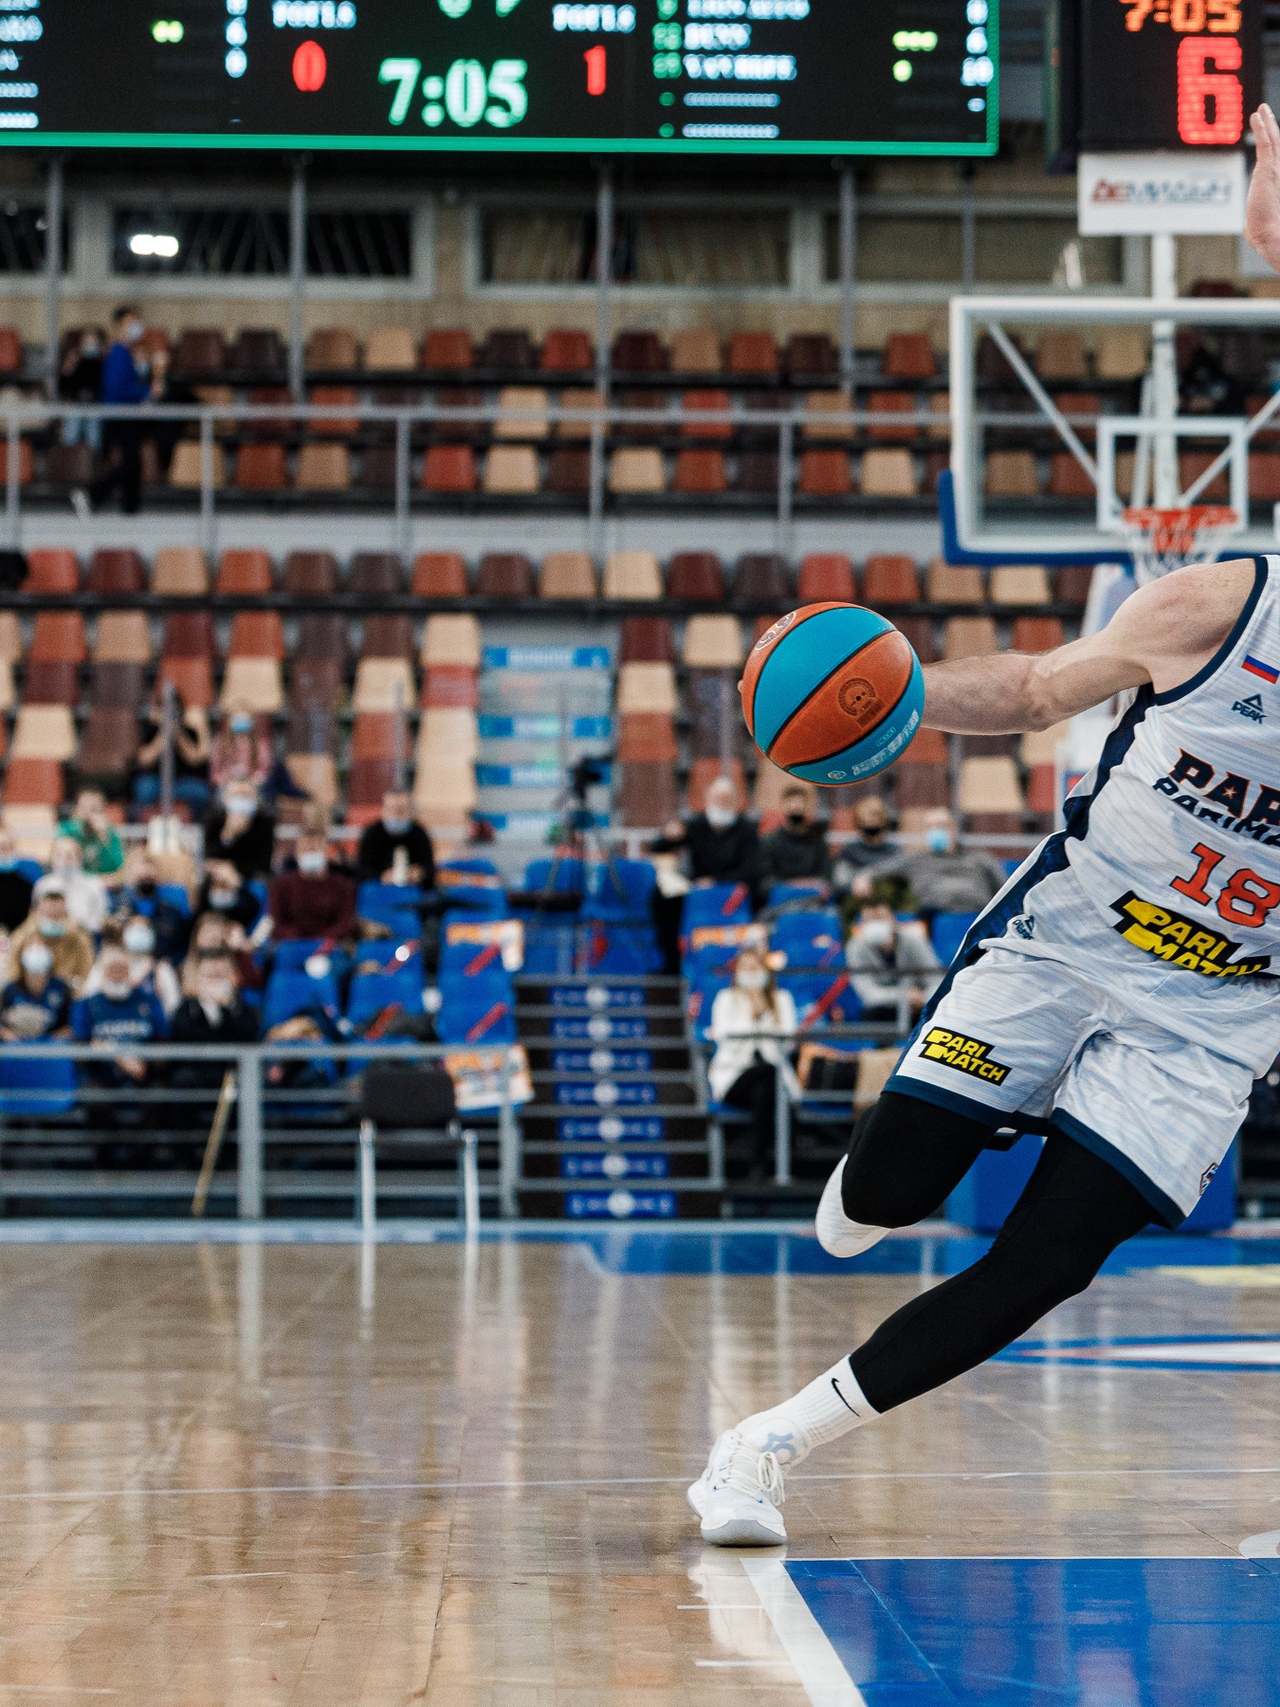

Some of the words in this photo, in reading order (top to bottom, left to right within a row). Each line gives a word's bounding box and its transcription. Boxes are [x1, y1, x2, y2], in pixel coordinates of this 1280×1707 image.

[1118, 0, 1242, 32] 7:05
[292, 40, 327, 92] 0
[583, 45, 606, 96] 1
[1177, 36, 1243, 144] 6
[378, 58, 528, 128] 7:05
[1231, 700, 1269, 725] PEAK
[1123, 898, 1228, 960] PARI
[924, 1043, 1006, 1081] MATCH
[925, 1029, 986, 1058] PARI
